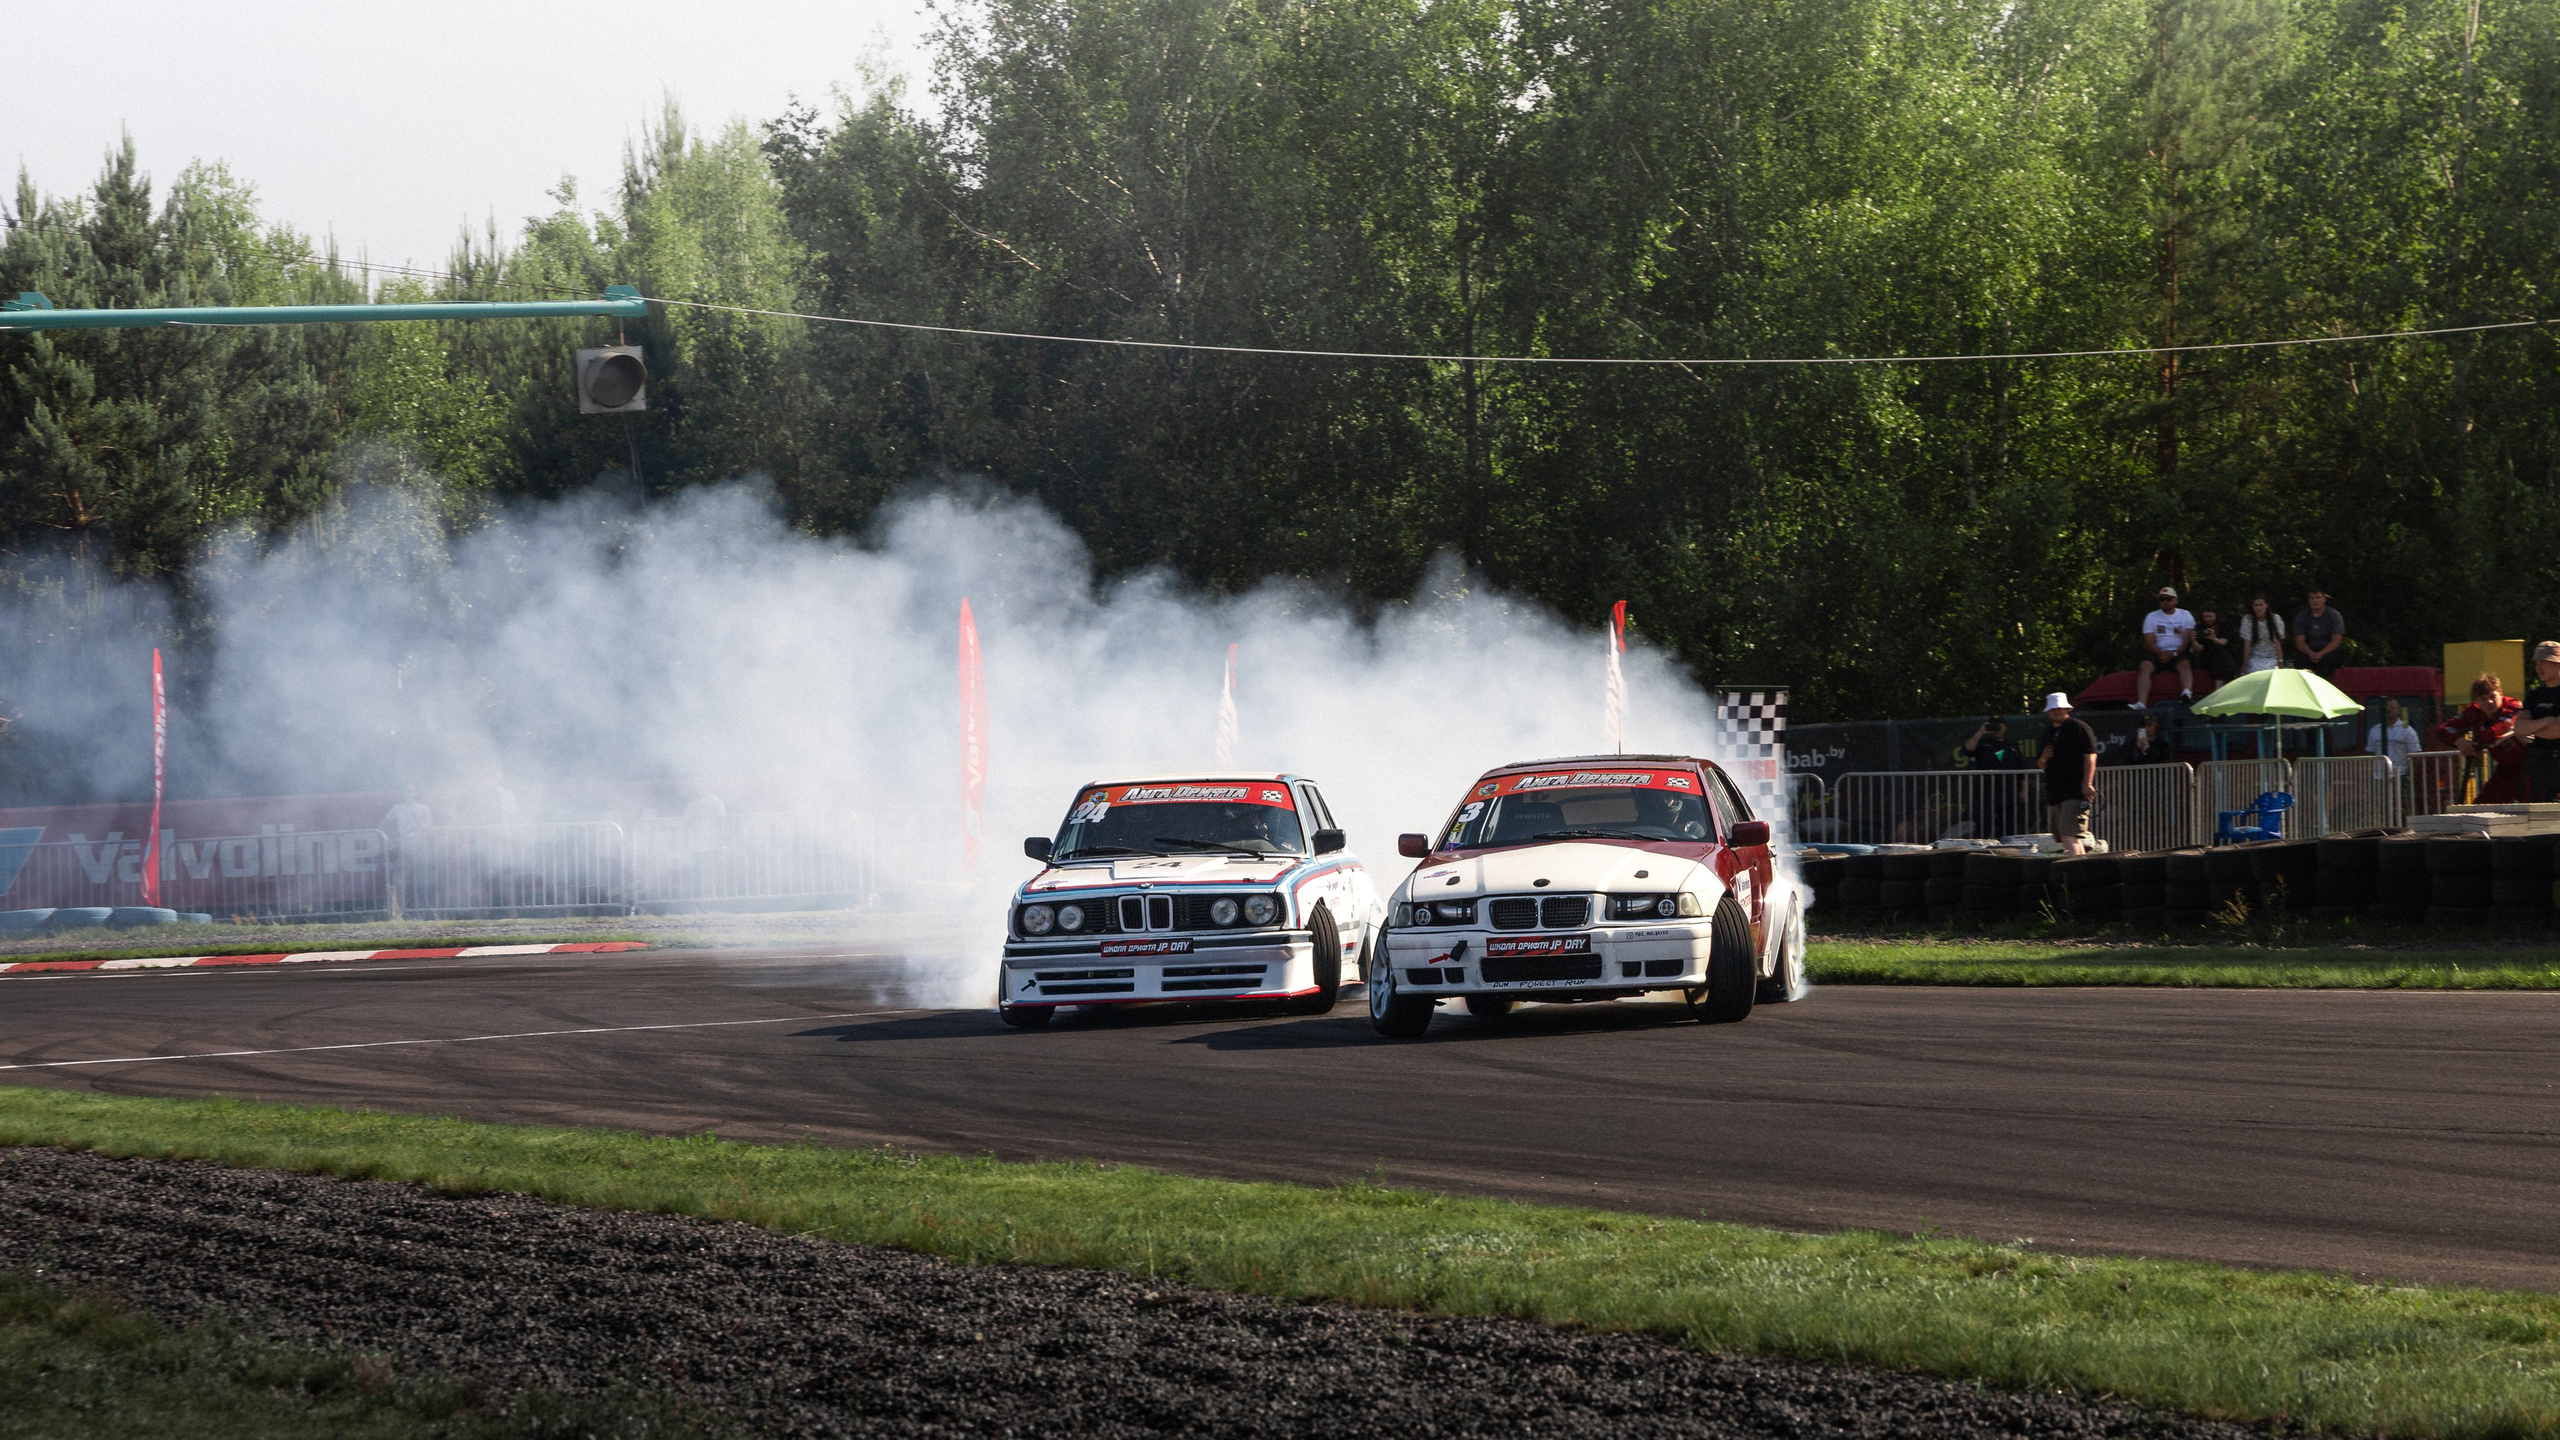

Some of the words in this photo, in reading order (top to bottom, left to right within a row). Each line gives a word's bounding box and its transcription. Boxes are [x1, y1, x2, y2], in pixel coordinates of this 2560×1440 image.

[1784, 746, 1846, 768] bab.by
[1953, 739, 2037, 768] gill
[1069, 801, 1112, 825] 24
[1458, 801, 1485, 823] 3
[68, 823, 381, 884] Valvoline
[1132, 861, 1183, 869] 24
[1103, 945, 1127, 953] ШКОЛА
[1127, 943, 1157, 952] ДРИФТА
[1157, 942, 1169, 952] JP
[1170, 941, 1190, 951] DAY
[1489, 943, 1516, 951] ШКОЛА
[1517, 942, 1550, 950] ДРИФТА
[1550, 941, 1562, 950] JP
[1564, 939, 1587, 949] DAY
[1493, 981, 1510, 989] RUN
[1519, 980, 1557, 988] FOREST
